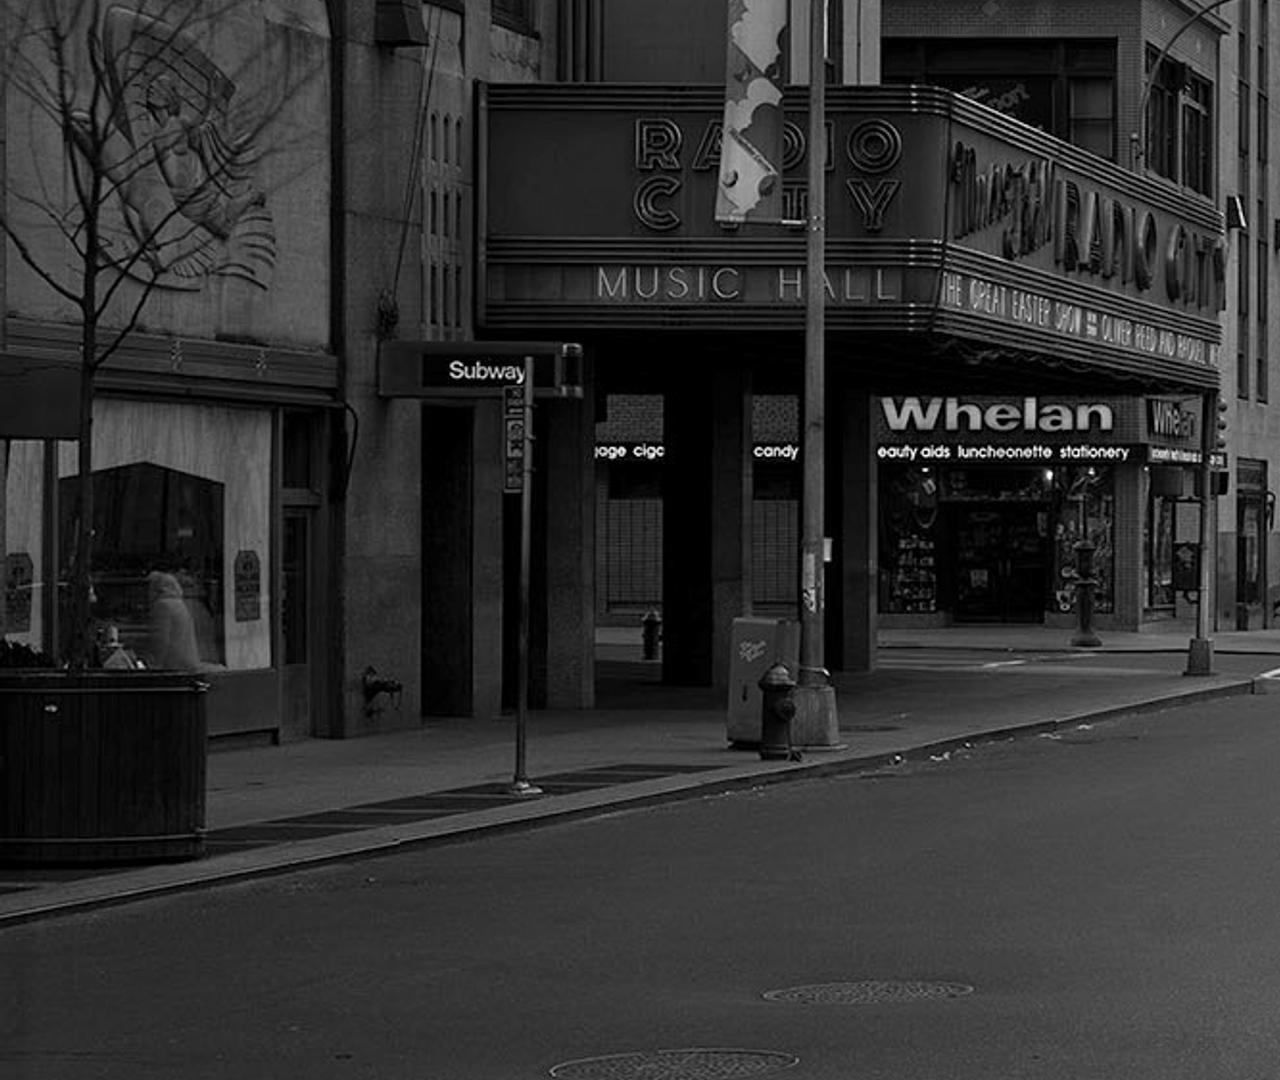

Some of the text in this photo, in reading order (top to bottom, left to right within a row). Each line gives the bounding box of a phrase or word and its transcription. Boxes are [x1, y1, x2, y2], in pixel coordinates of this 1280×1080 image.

[633, 175, 902, 232] CTY
[1053, 179, 1157, 292] RADIO
[597, 267, 739, 299] MUSIC
[941, 271, 962, 307] THE
[969, 279, 1006, 315] GREAT
[1012, 290, 1051, 326] EASTER
[448, 360, 525, 385] Subway
[880, 396, 1113, 432] Whelan
[752, 443, 800, 461] candy
[920, 443, 952, 459] aids
[957, 444, 1053, 459] luncheonette
[1059, 444, 1130, 461] stationery
